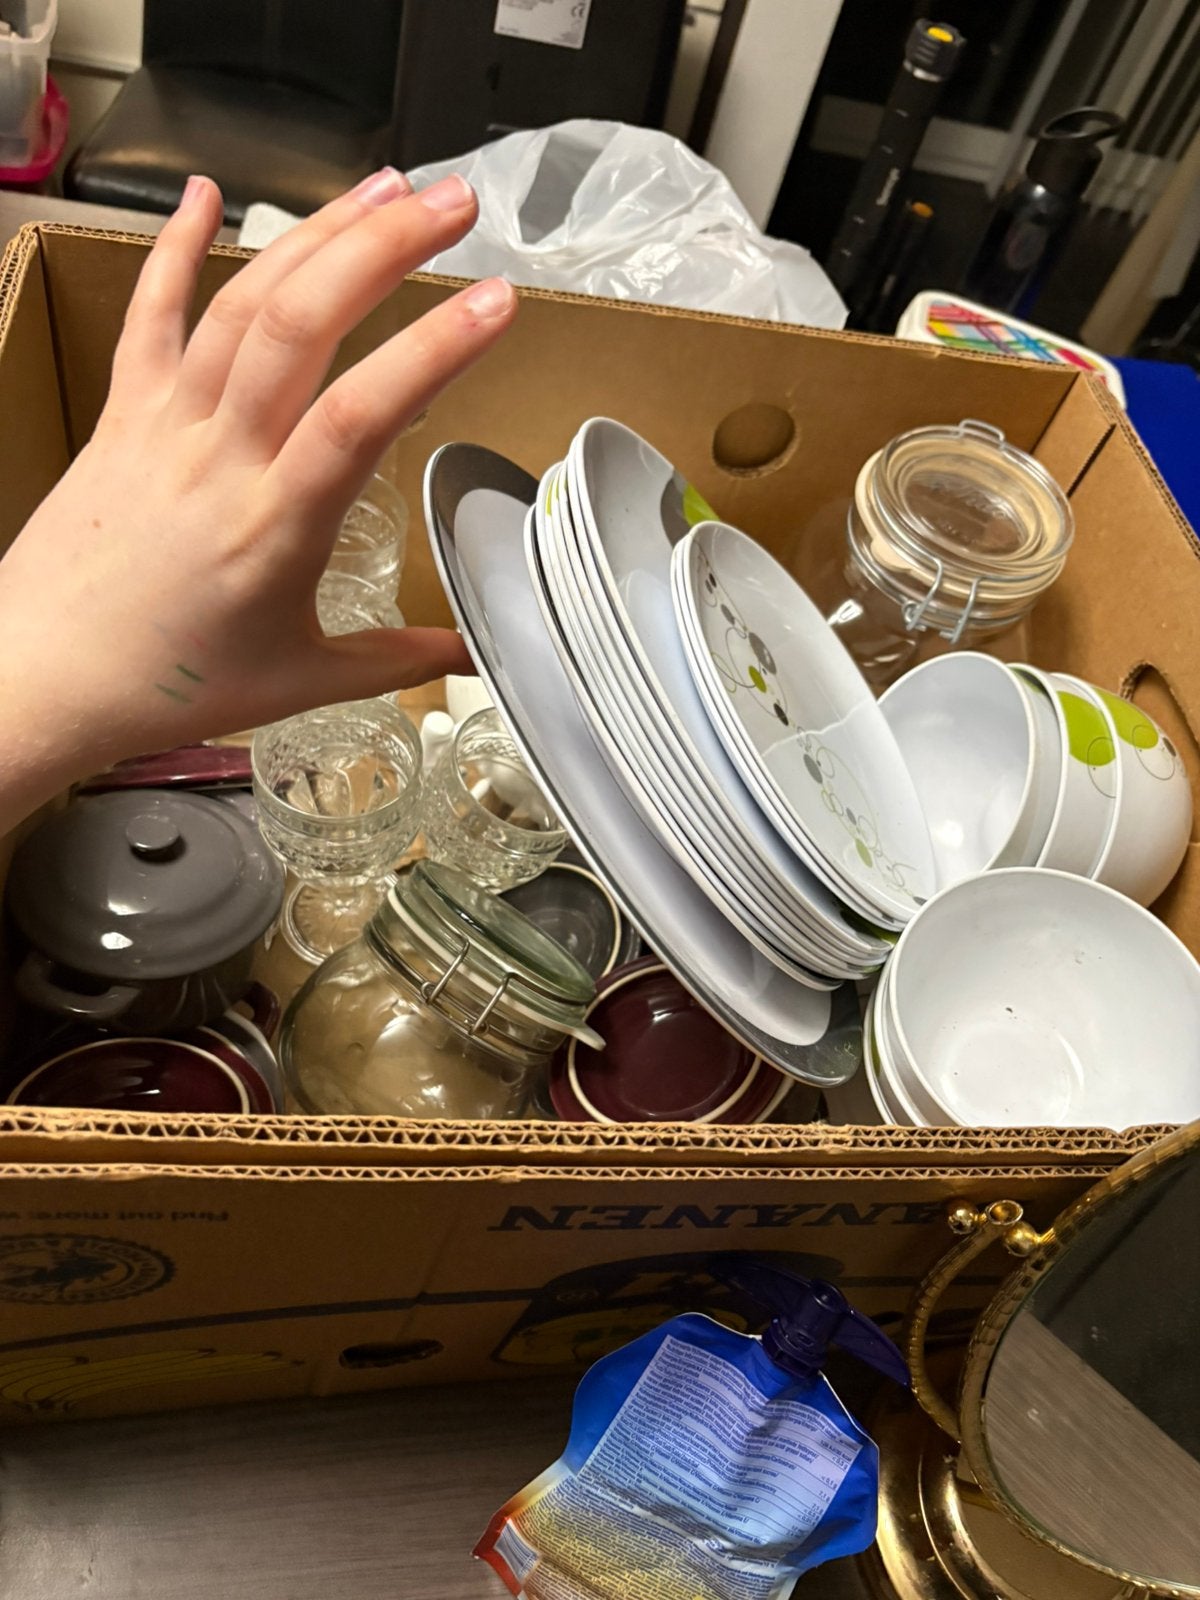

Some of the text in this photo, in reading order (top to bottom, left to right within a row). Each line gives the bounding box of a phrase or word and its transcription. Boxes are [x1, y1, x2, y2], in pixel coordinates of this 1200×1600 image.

[119, 1211, 164, 1221] out
[171, 1211, 230, 1222] Find
[486, 1201, 947, 1232] ANANEN
